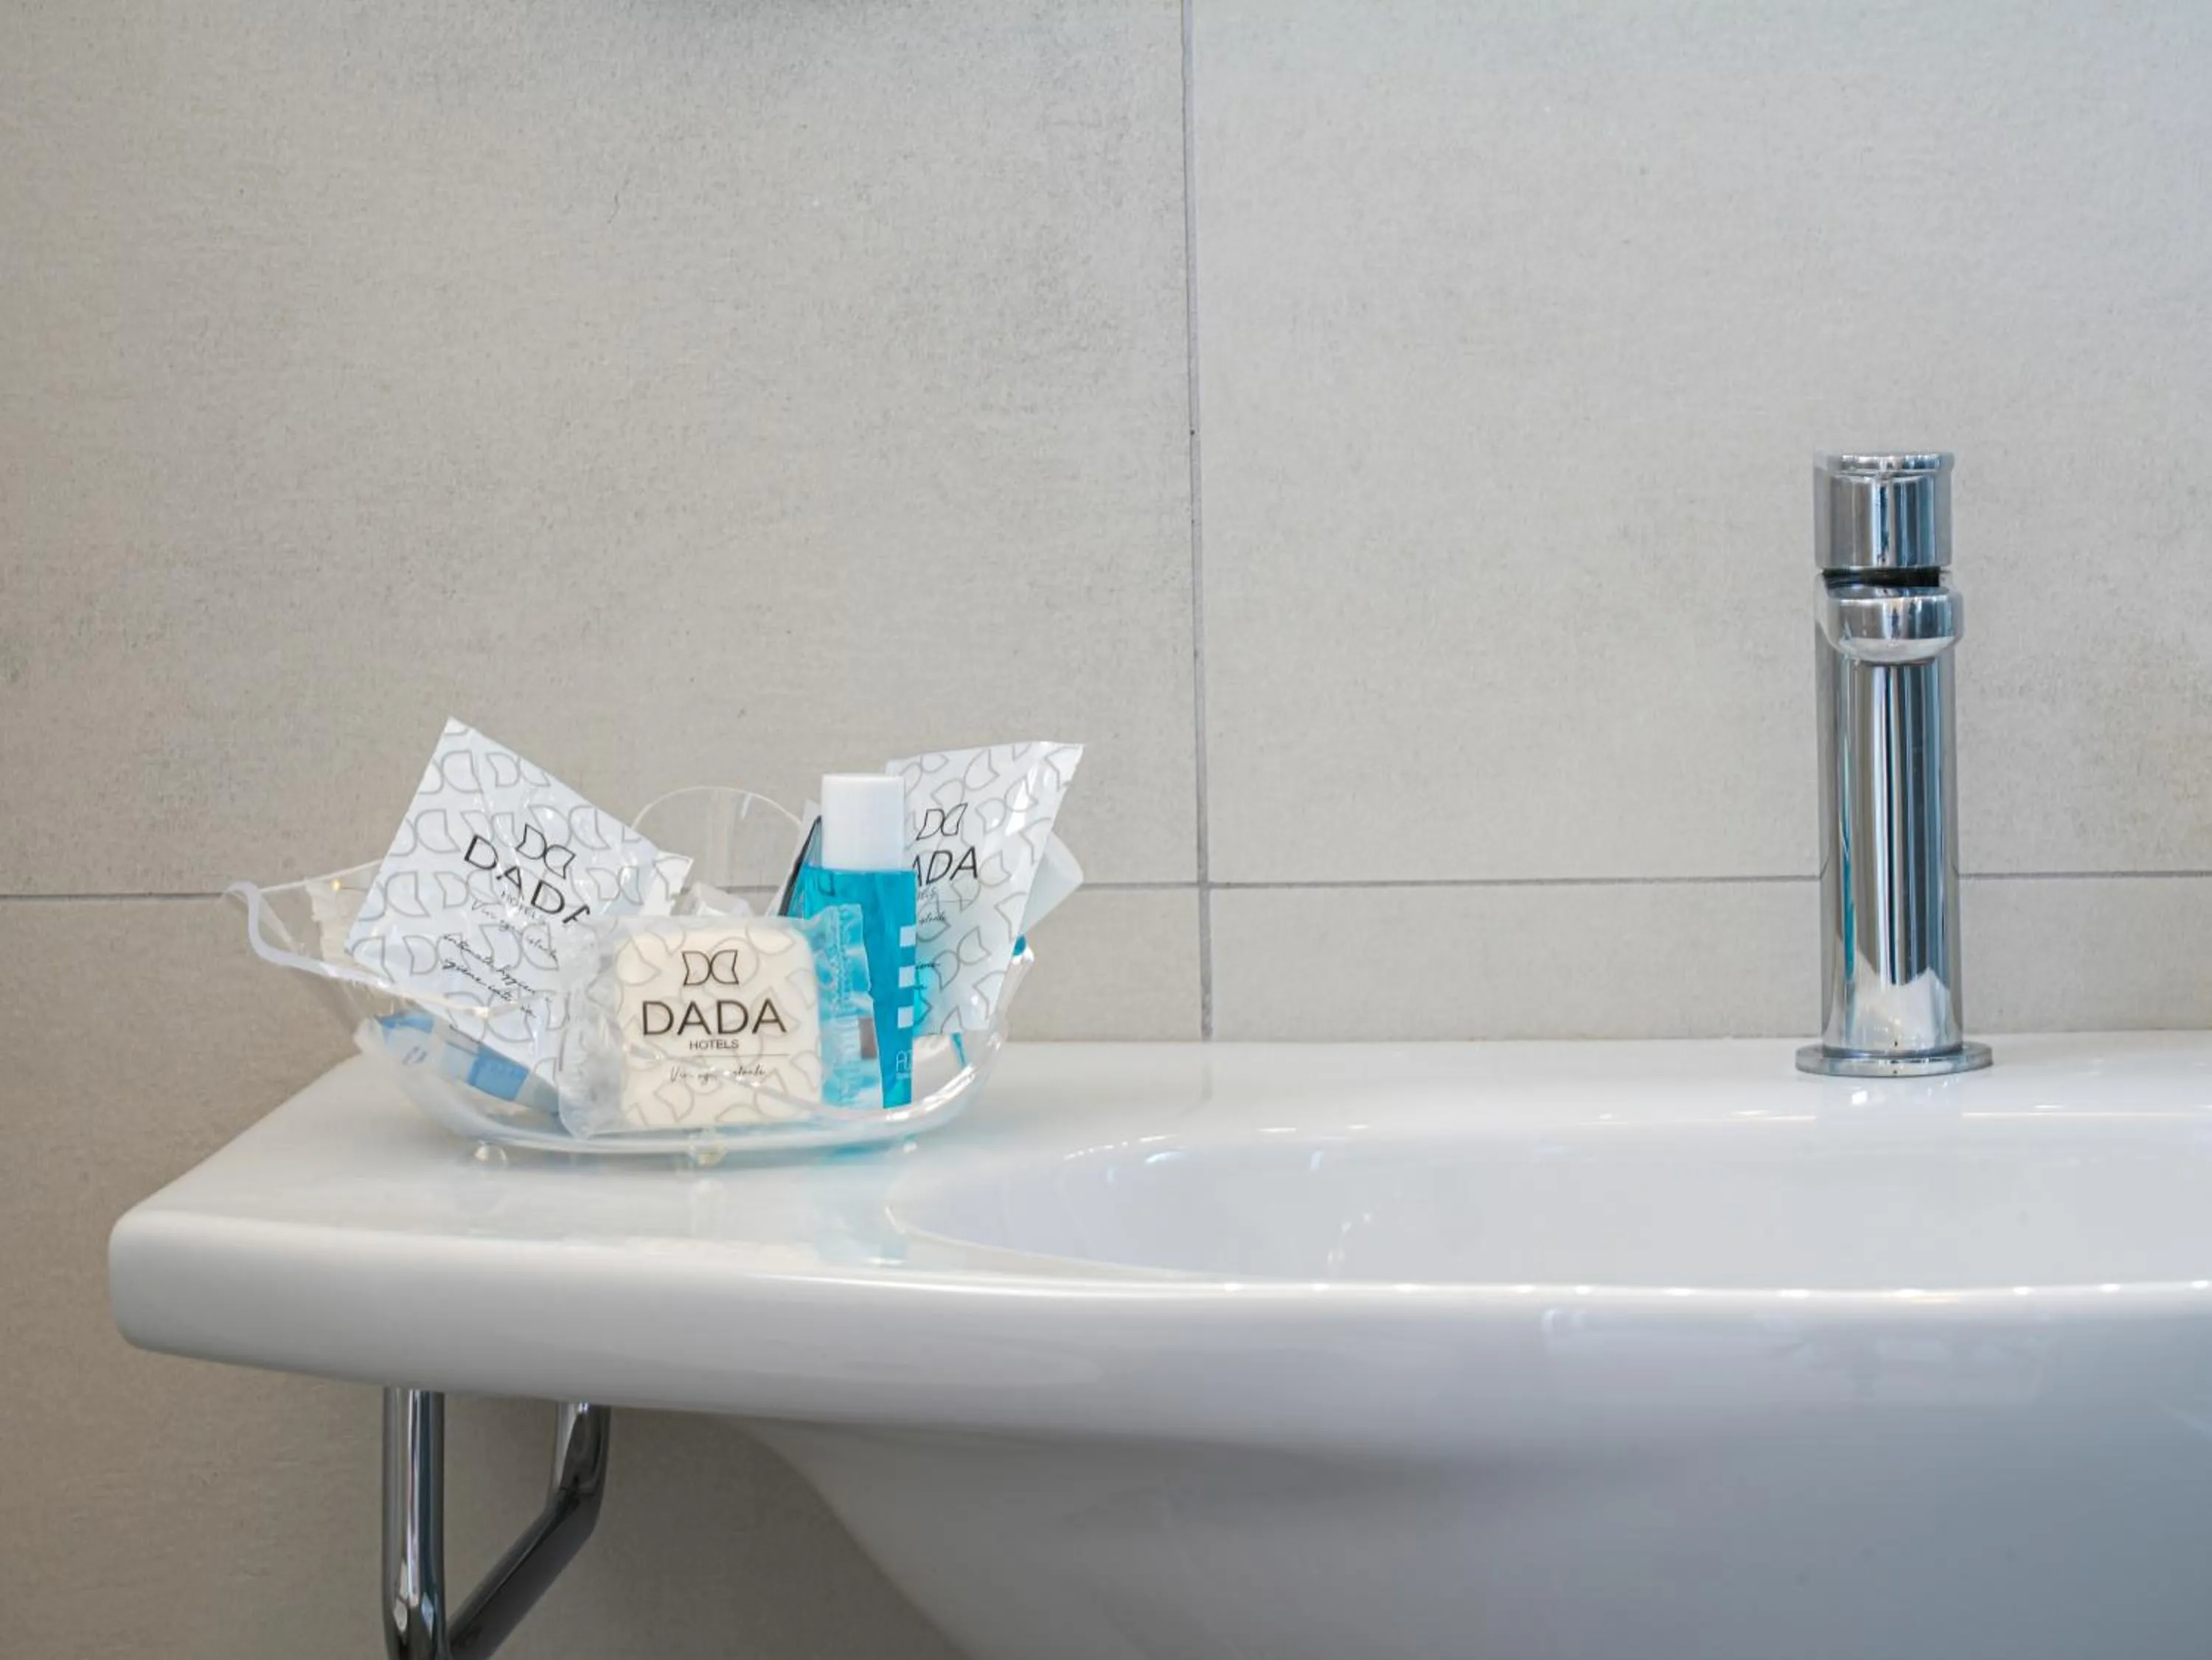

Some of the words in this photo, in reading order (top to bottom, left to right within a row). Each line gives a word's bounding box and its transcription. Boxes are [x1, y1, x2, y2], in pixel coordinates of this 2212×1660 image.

[912, 845, 978, 886] ADA
[643, 998, 787, 1035] DADA
[689, 1039, 740, 1050] HOTELS
